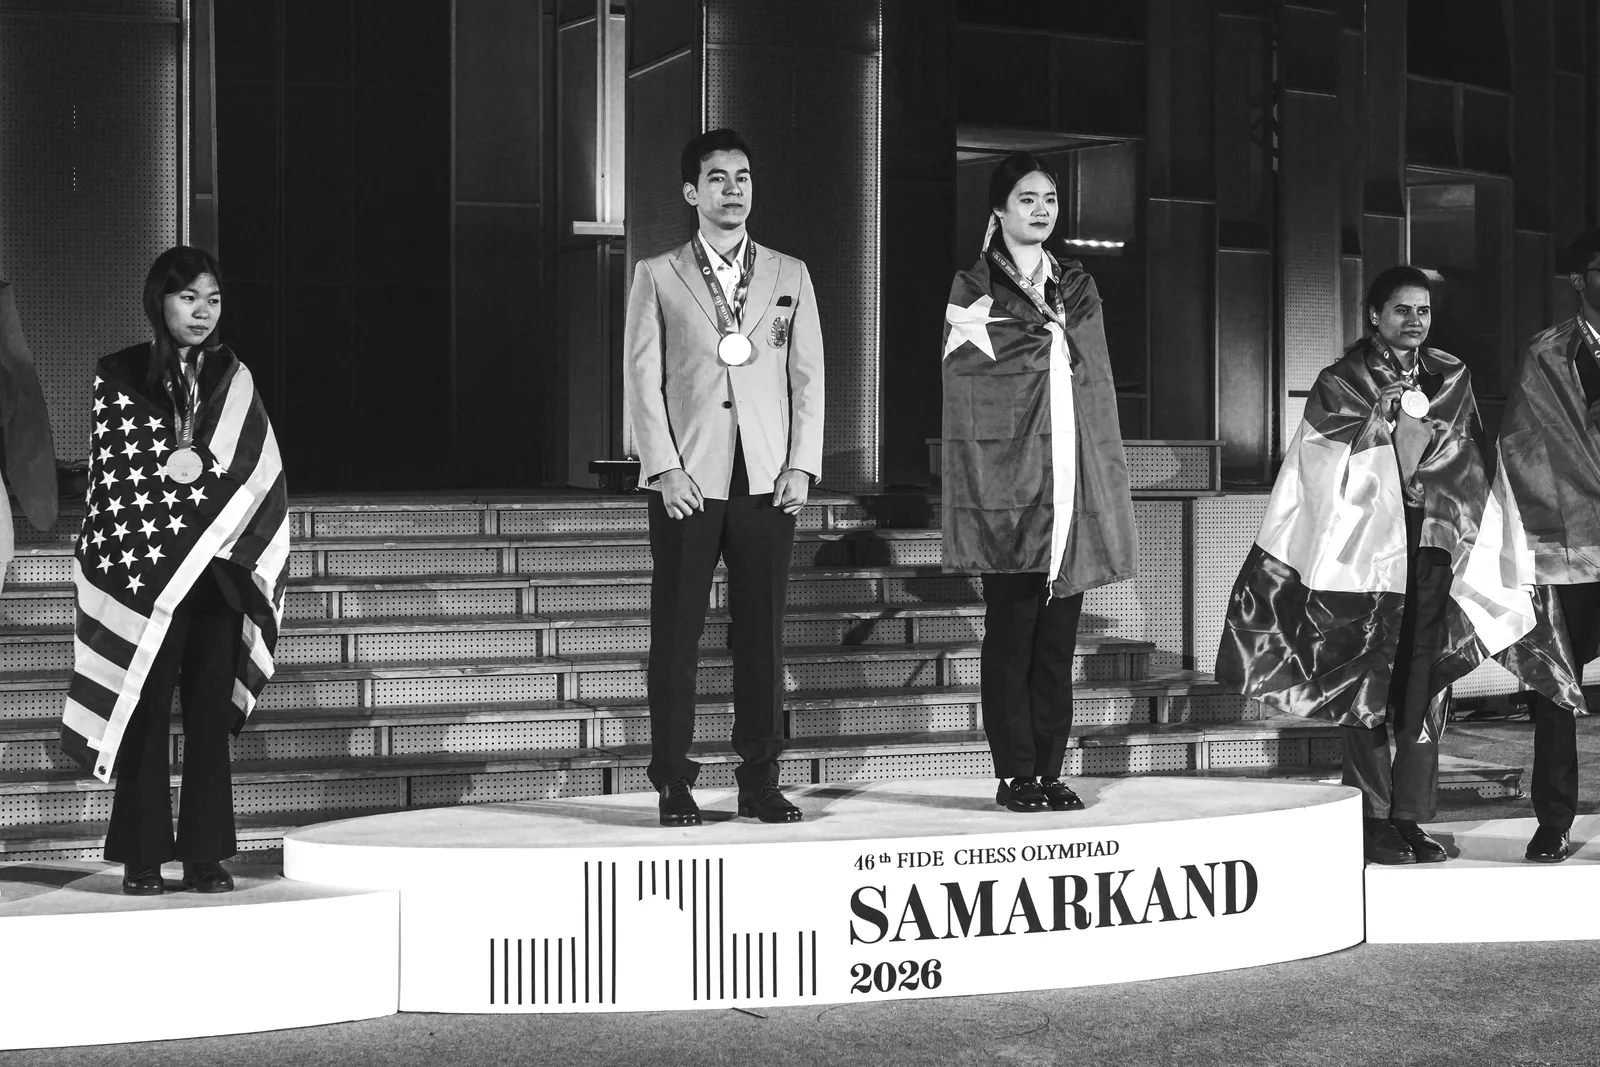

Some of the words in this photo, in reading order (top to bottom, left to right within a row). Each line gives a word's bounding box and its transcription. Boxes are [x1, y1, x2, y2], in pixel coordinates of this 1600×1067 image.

[854, 854, 875, 871] 46
[879, 852, 892, 864] th
[897, 850, 945, 869] FIDE
[954, 847, 1016, 866] CHESS
[1021, 840, 1120, 862] OLYMPIAD
[849, 859, 1258, 946] SAMARKAND
[850, 958, 942, 994] 2026
